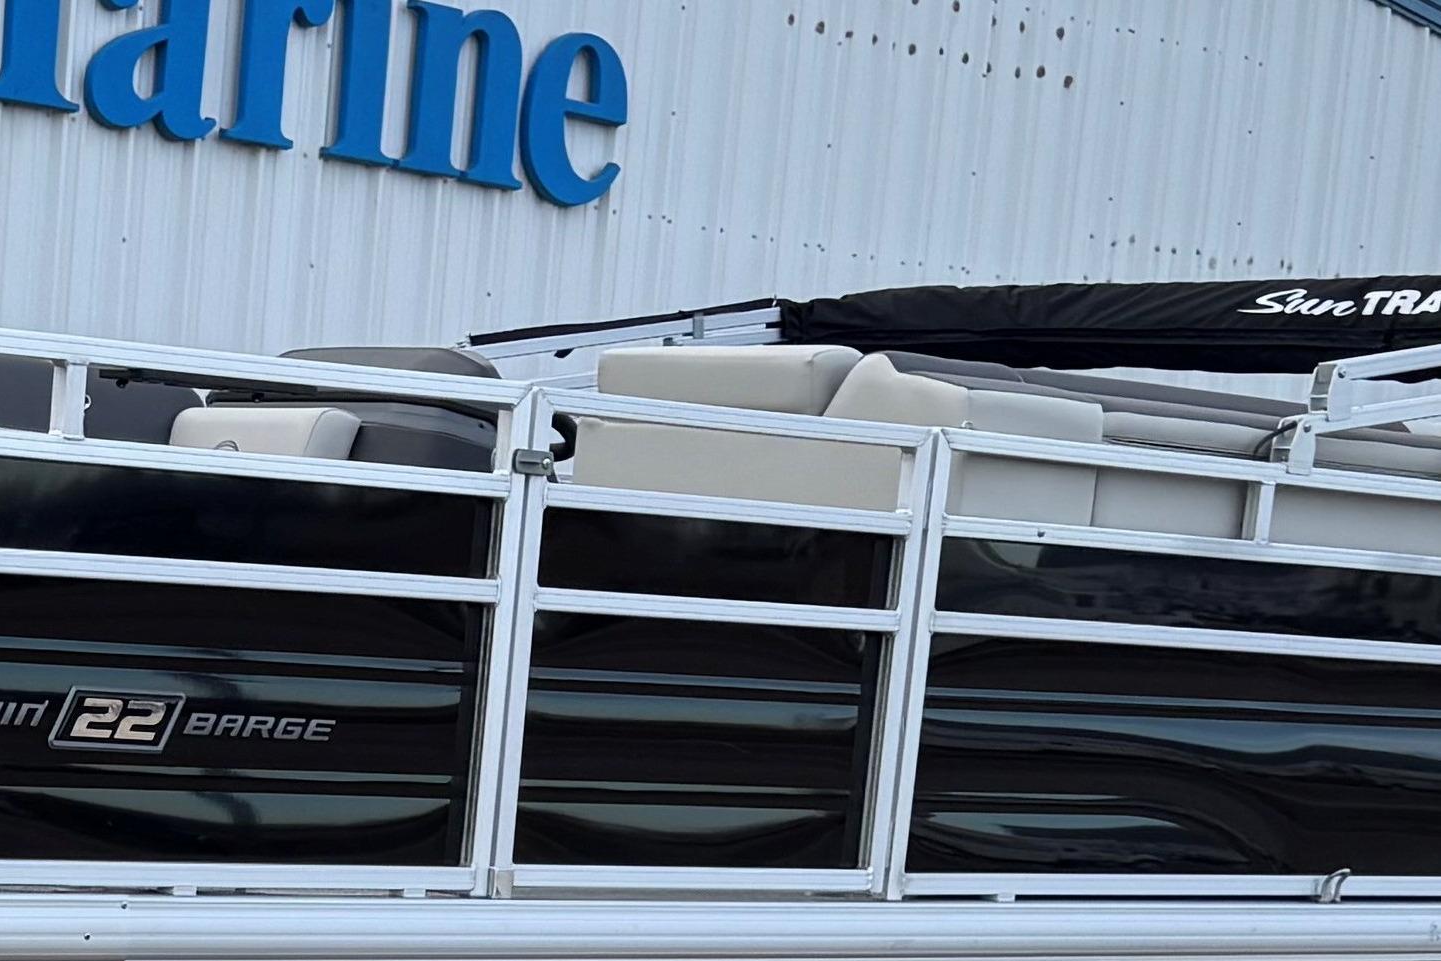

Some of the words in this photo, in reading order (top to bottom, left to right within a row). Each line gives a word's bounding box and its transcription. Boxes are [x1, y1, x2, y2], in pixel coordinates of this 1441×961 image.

[1237, 288, 1357, 317] Sun
[69, 697, 167, 741] 22
[183, 712, 336, 741] BARGE
